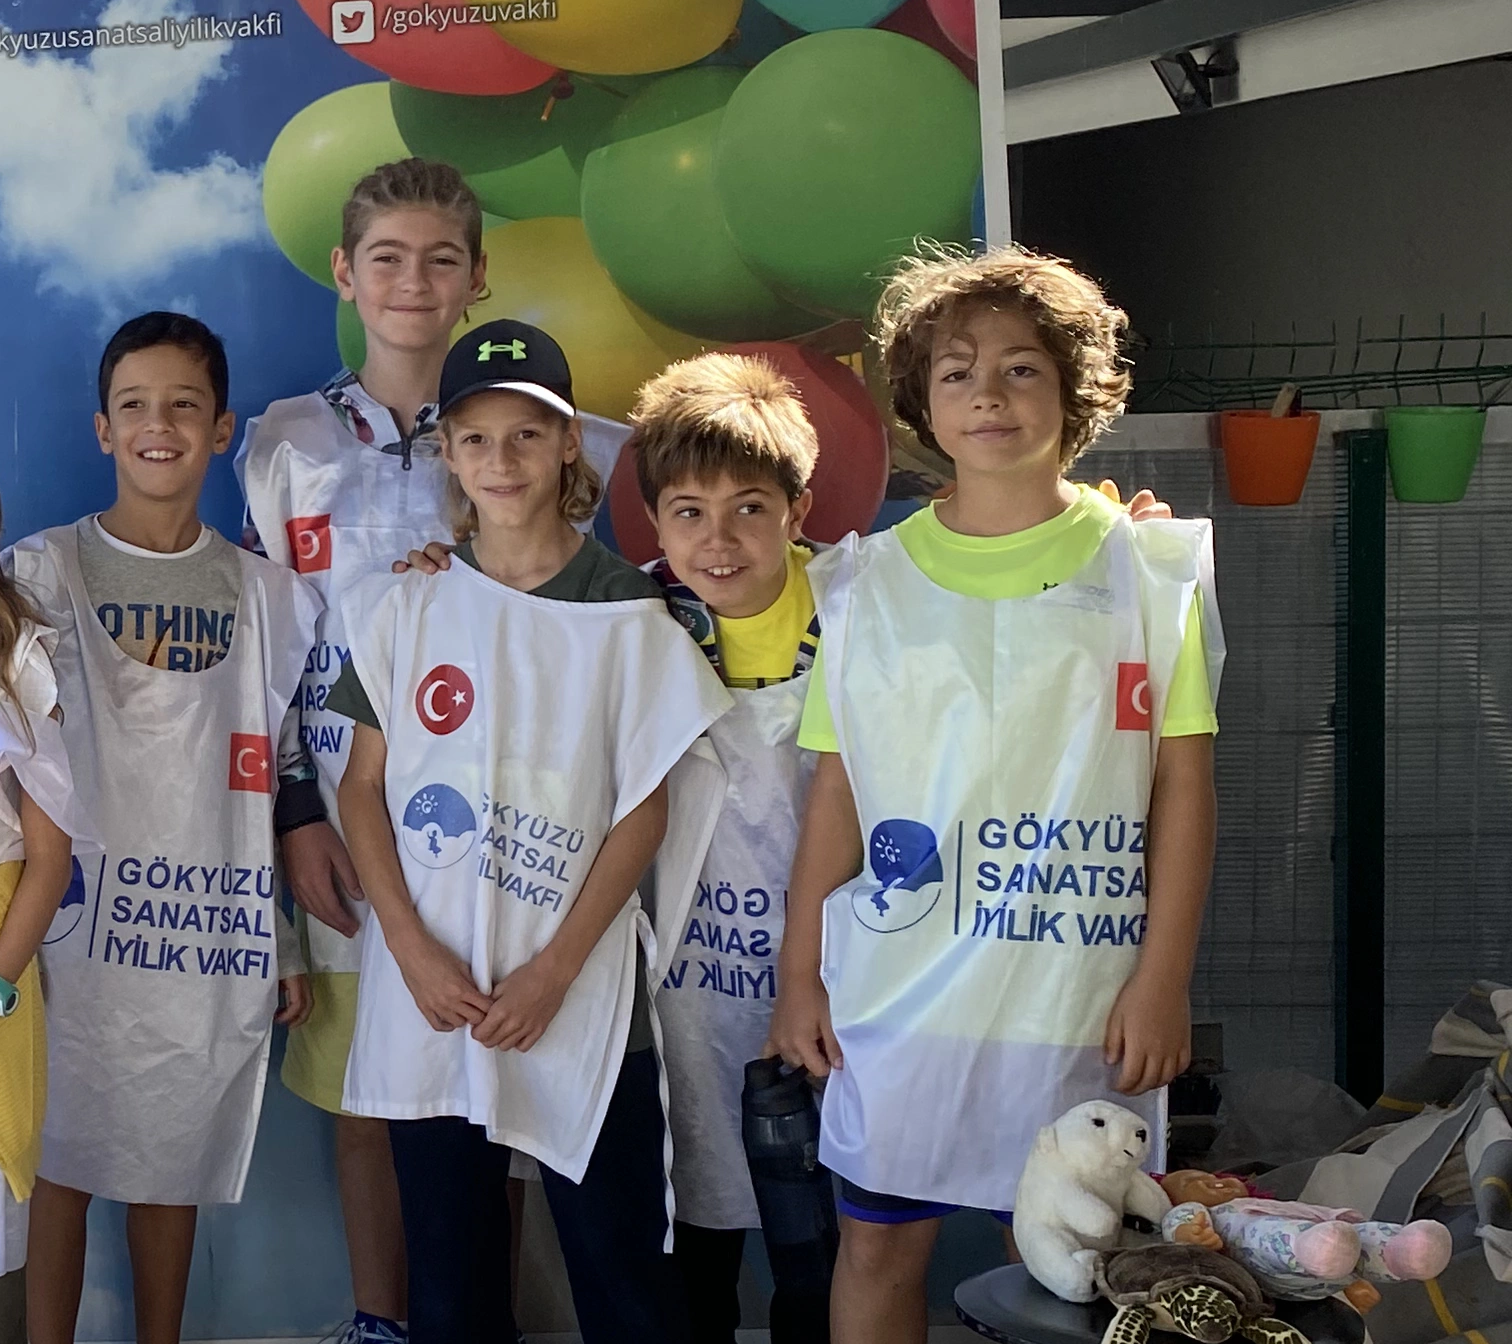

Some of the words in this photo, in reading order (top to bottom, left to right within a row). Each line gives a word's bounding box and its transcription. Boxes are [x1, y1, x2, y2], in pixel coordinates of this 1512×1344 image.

[97, 602, 235, 649] OTHING
[977, 812, 1146, 854] GÖKYÜZ
[117, 855, 275, 900] GÖKYÜZÜ
[976, 860, 1149, 898] SANATSA
[110, 895, 273, 939] SANATSAL
[103, 929, 190, 973] İYİLİK
[196, 946, 270, 979] VAKFI
